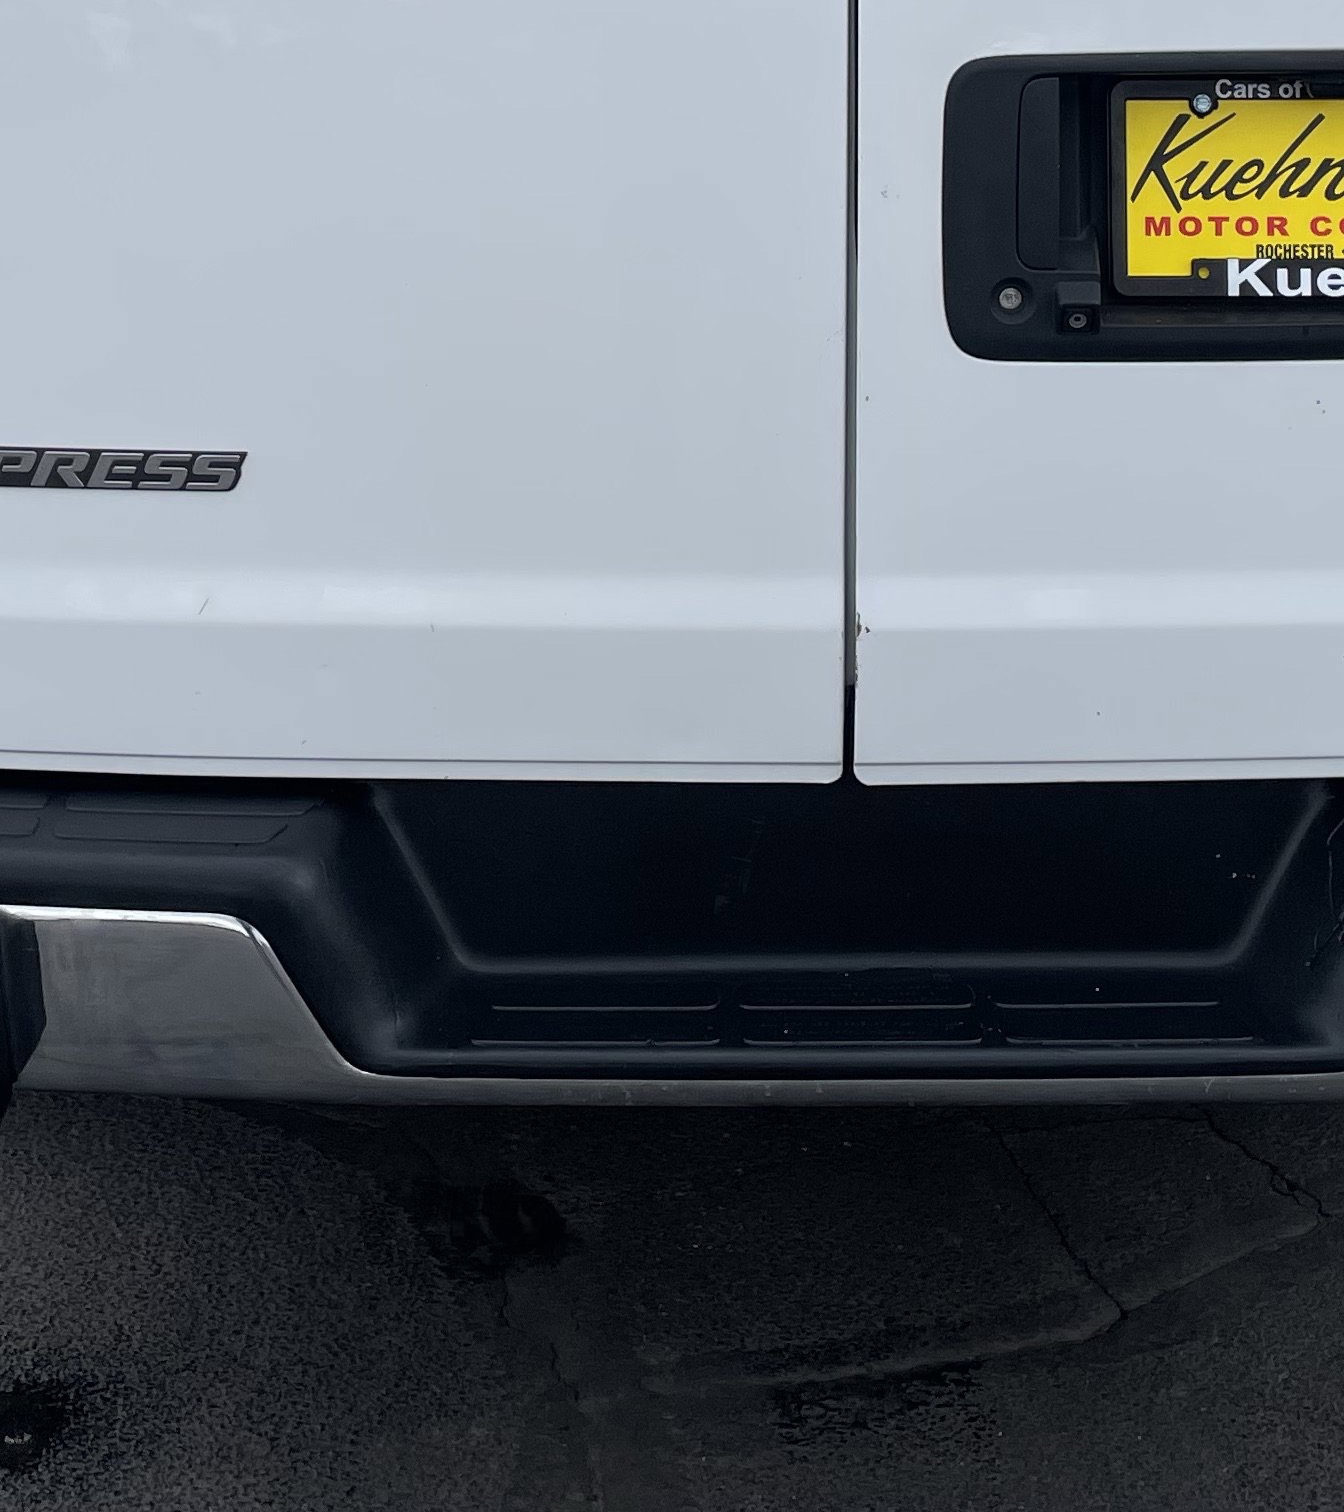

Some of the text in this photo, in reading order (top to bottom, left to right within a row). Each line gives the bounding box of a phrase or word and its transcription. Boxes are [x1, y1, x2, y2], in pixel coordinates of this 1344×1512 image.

[1215, 79, 1271, 99] Cars
[1278, 79, 1305, 99] of
[1143, 215, 1291, 238] MOTOR
[1255, 243, 1335, 261] ROCHESTER
